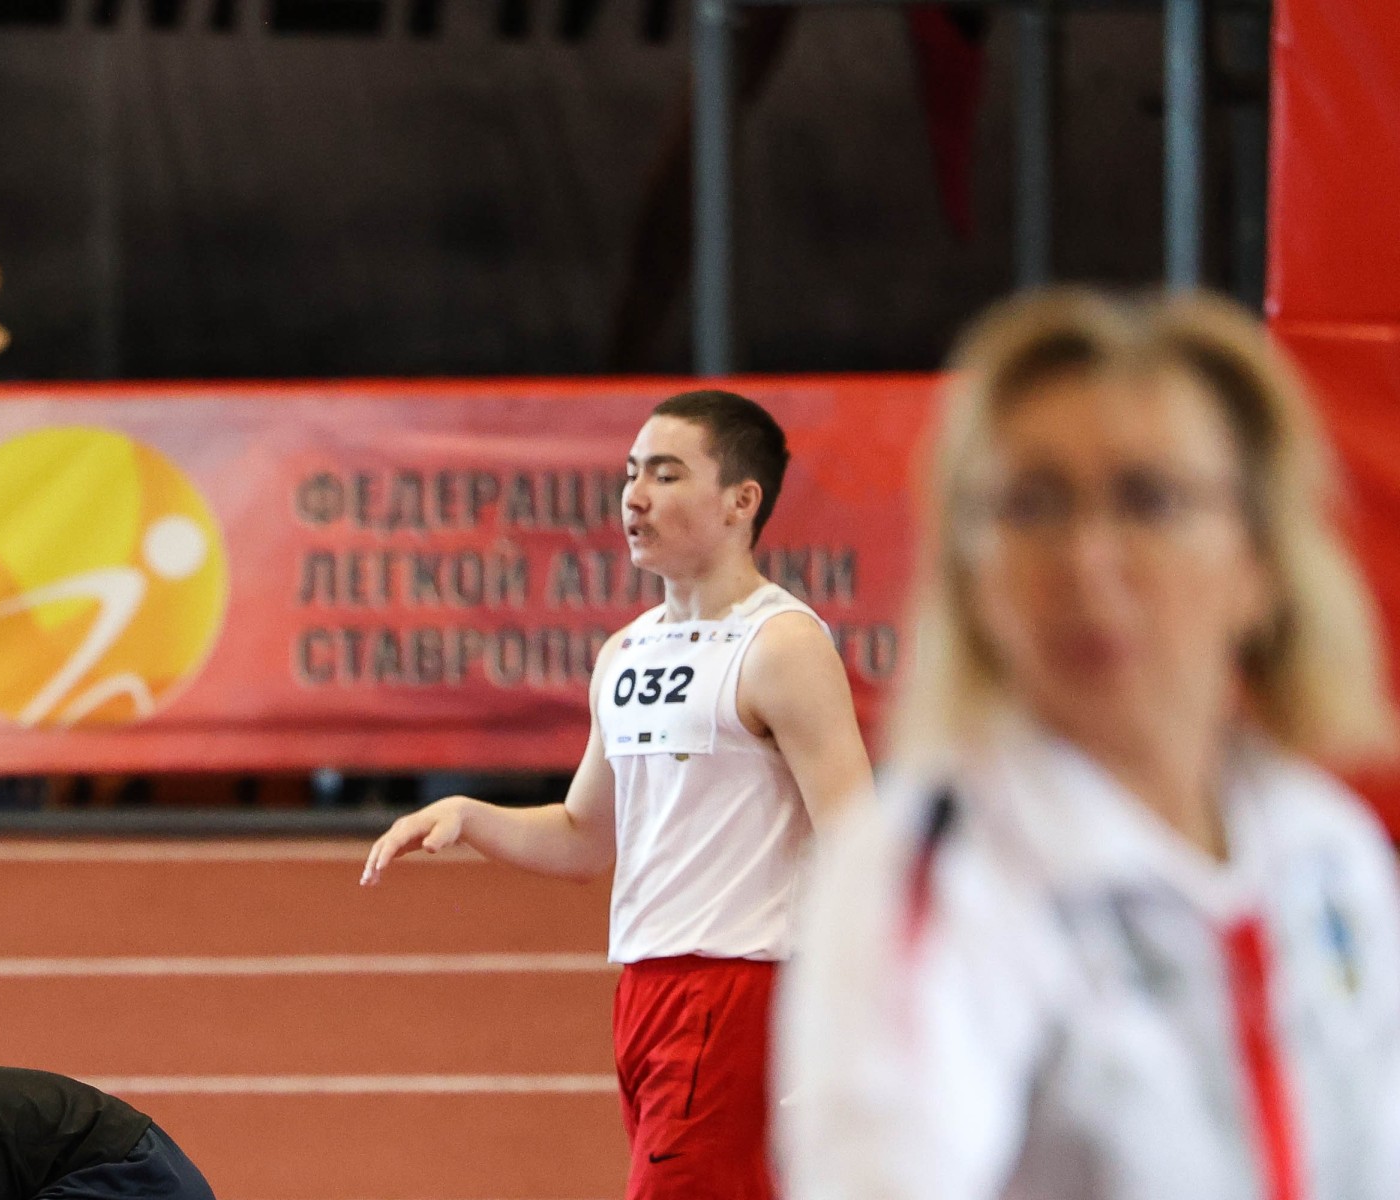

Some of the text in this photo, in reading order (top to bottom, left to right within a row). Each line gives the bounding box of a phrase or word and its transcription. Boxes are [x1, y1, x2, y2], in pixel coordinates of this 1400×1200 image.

[295, 468, 628, 536] ФЕДЕРАЦИ
[297, 540, 530, 607] ЛЕГКОЙ
[614, 665, 695, 708] 032
